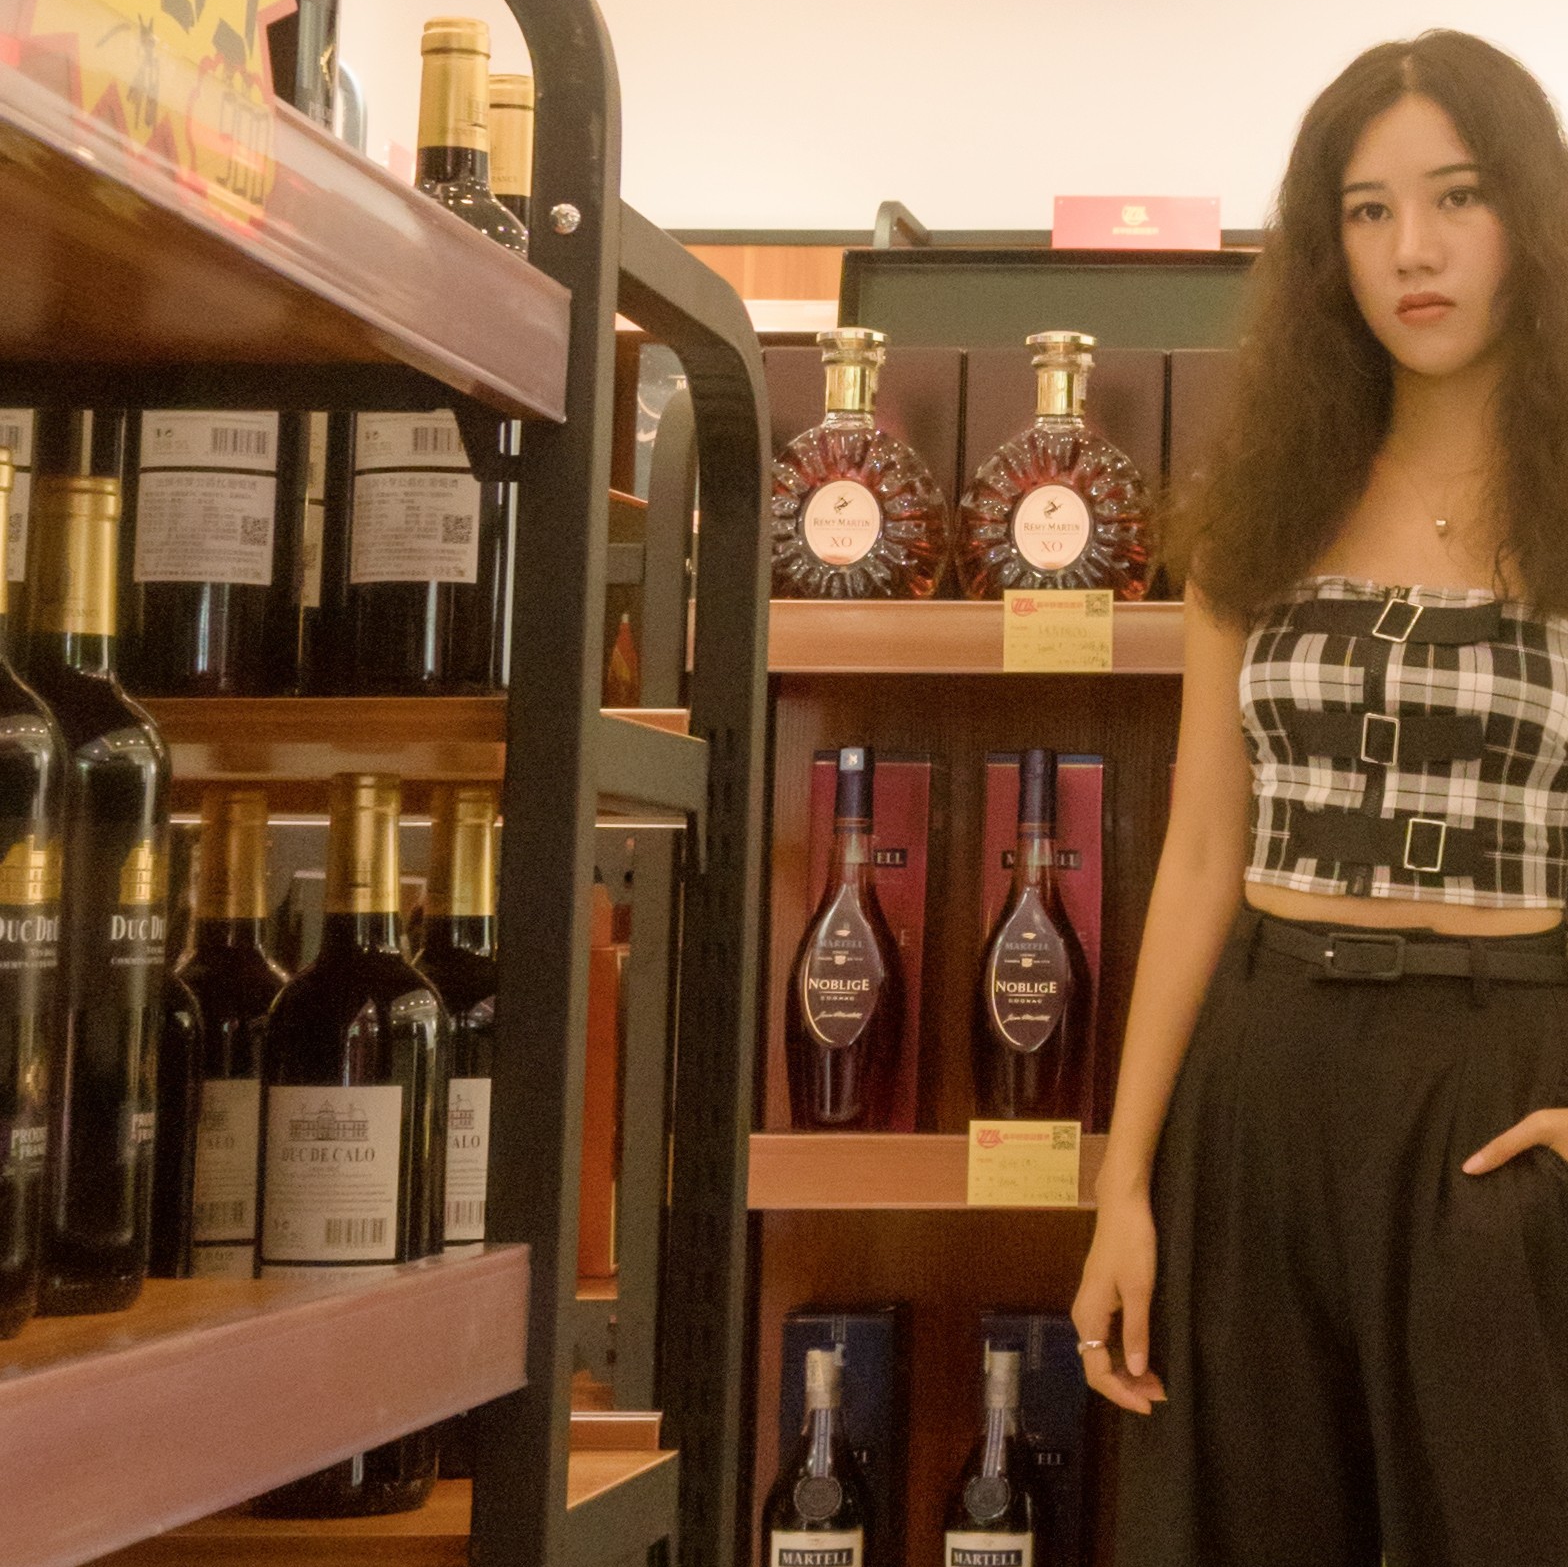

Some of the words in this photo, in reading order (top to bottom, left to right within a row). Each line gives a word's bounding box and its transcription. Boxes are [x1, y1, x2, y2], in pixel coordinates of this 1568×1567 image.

[837, 517, 871, 528] MARTIN
[1048, 522, 1081, 532] MARTIN
[829, 536, 853, 548] XO
[1040, 540, 1063, 553] XO
[110, 915, 147, 941] DUC
[808, 978, 871, 991] NOBLIGE
[995, 980, 1057, 994] NOBLIGE
[311, 1147, 329, 1163] DE
[332, 1147, 376, 1163] CALO
[781, 1550, 851, 1566] MARTELL
[954, 1550, 1019, 1566] MARTELL
